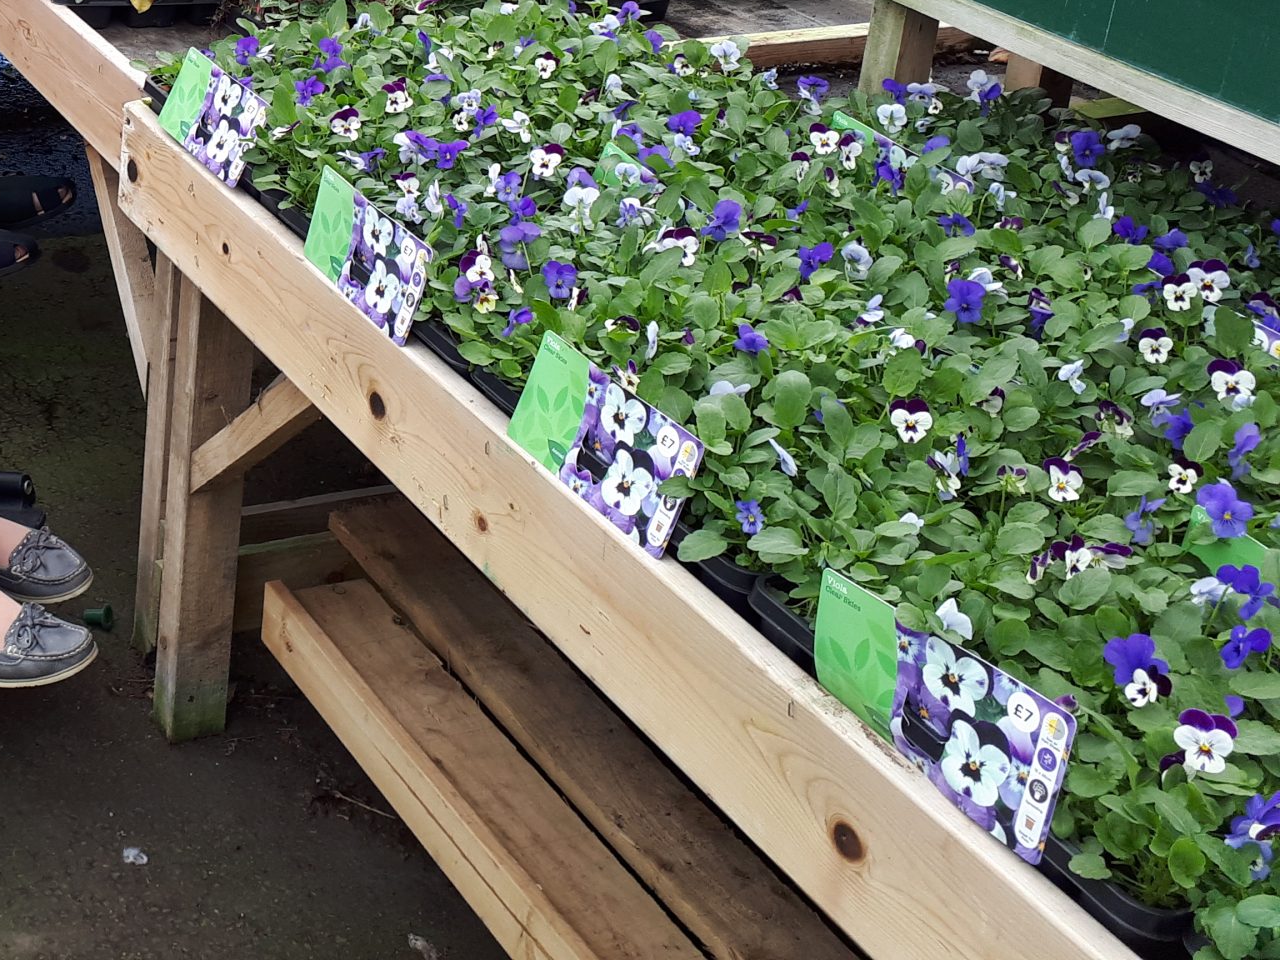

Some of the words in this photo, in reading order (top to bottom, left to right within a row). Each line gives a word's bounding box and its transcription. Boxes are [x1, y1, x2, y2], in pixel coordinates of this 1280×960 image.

[247, 104, 255, 115] £7
[403, 245, 414, 257] £7
[660, 434, 675, 449] £7
[827, 574, 848, 595] Viola
[825, 585, 843, 600] Clear
[843, 596, 861, 612] Skies
[1014, 704, 1034, 722] £7
